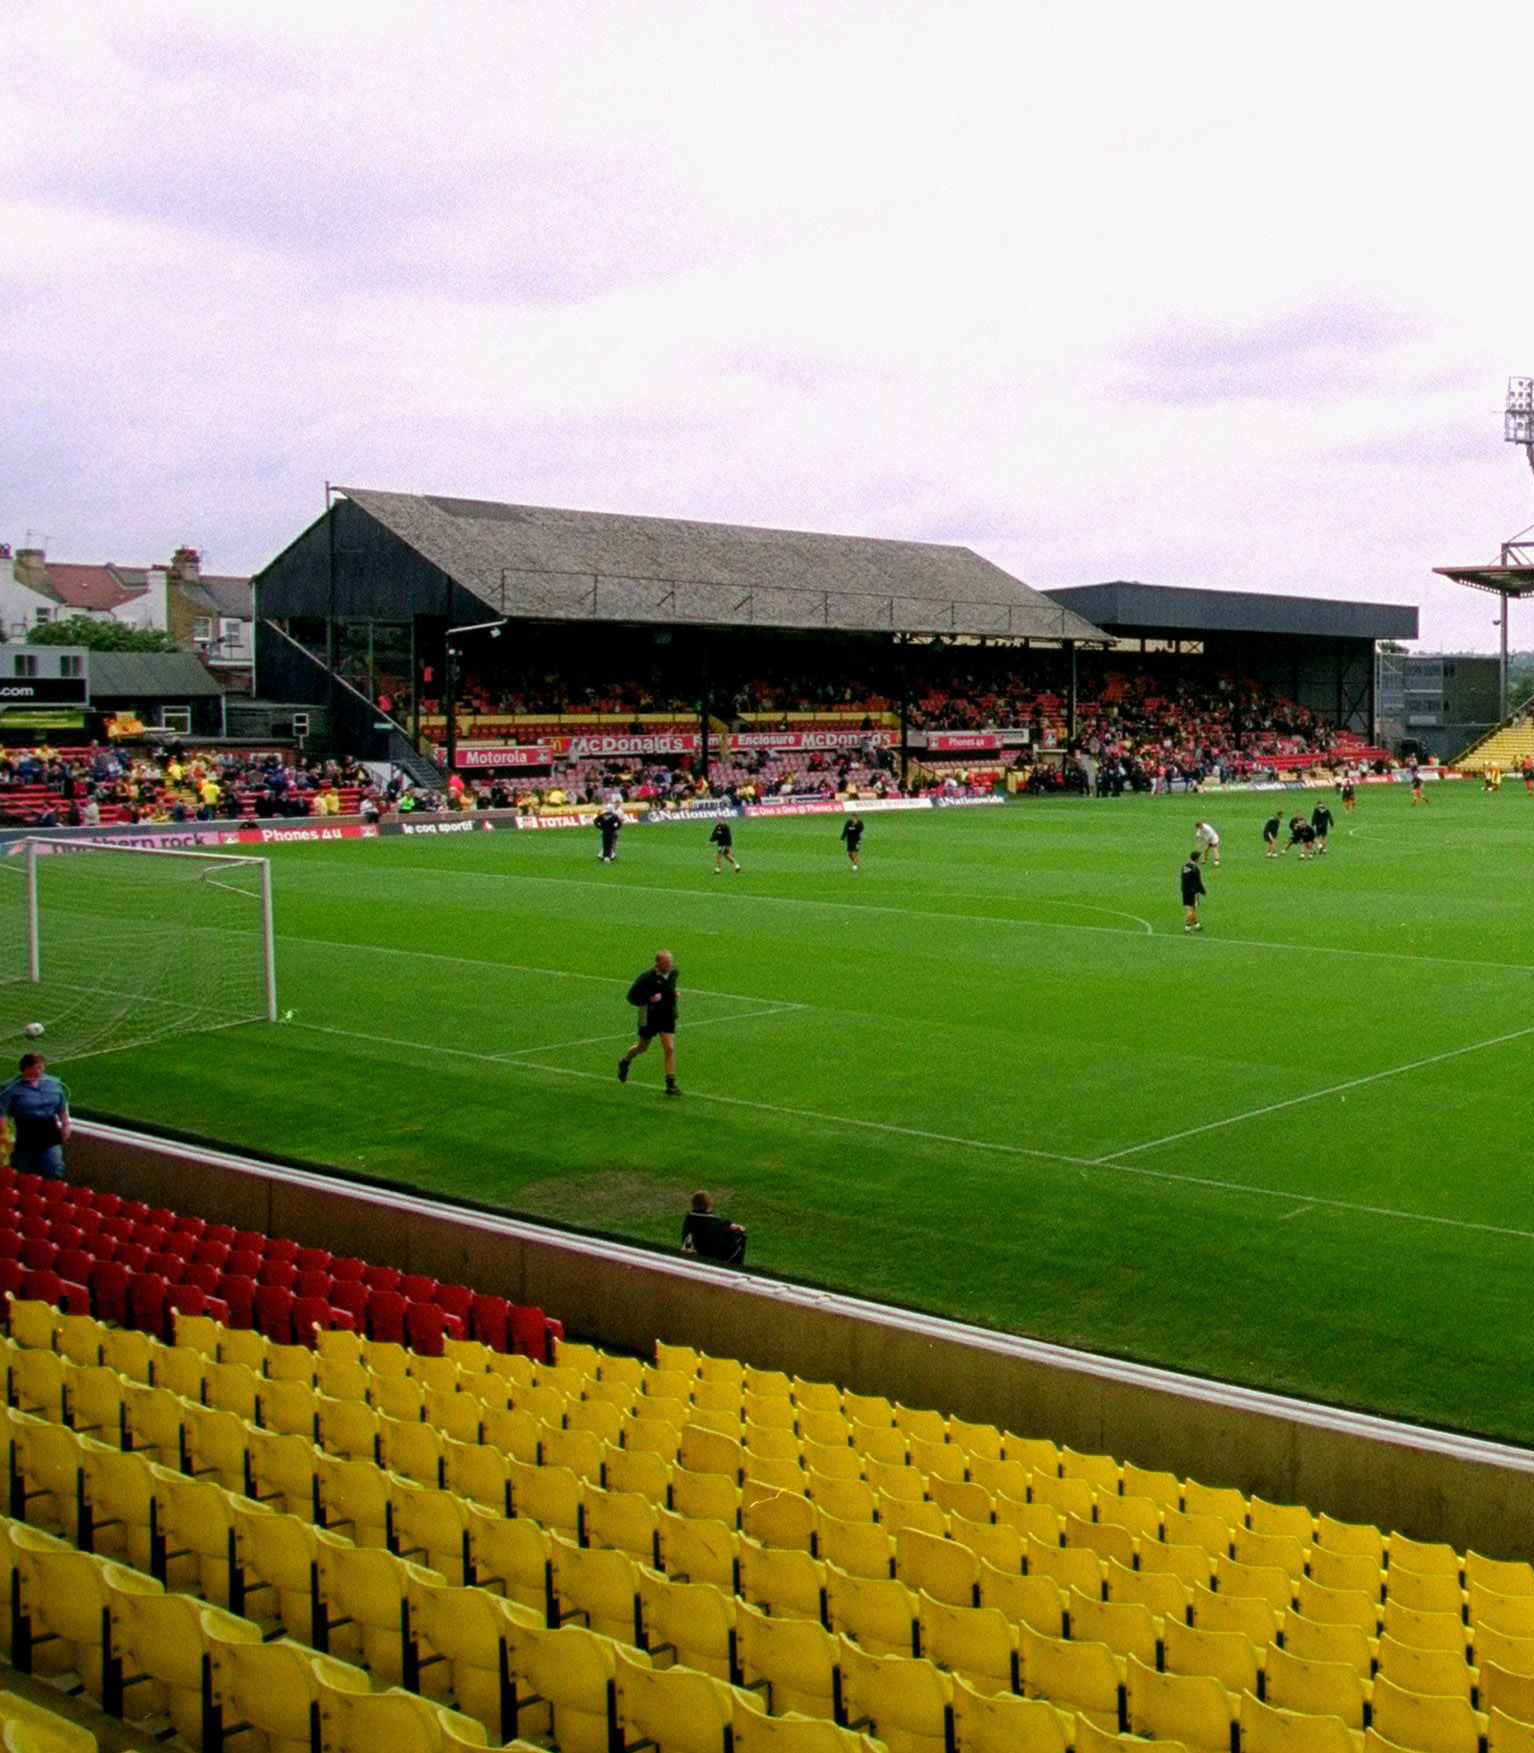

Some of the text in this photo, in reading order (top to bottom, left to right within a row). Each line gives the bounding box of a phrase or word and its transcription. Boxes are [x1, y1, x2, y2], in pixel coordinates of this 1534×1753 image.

[738, 733, 795, 746] Enclosure
[466, 750, 527, 765] Motorola
[541, 813, 579, 829] TOTAL
[658, 807, 738, 821] Nationwide
[161, 834, 205, 849] rock
[262, 829, 318, 843] Phones
